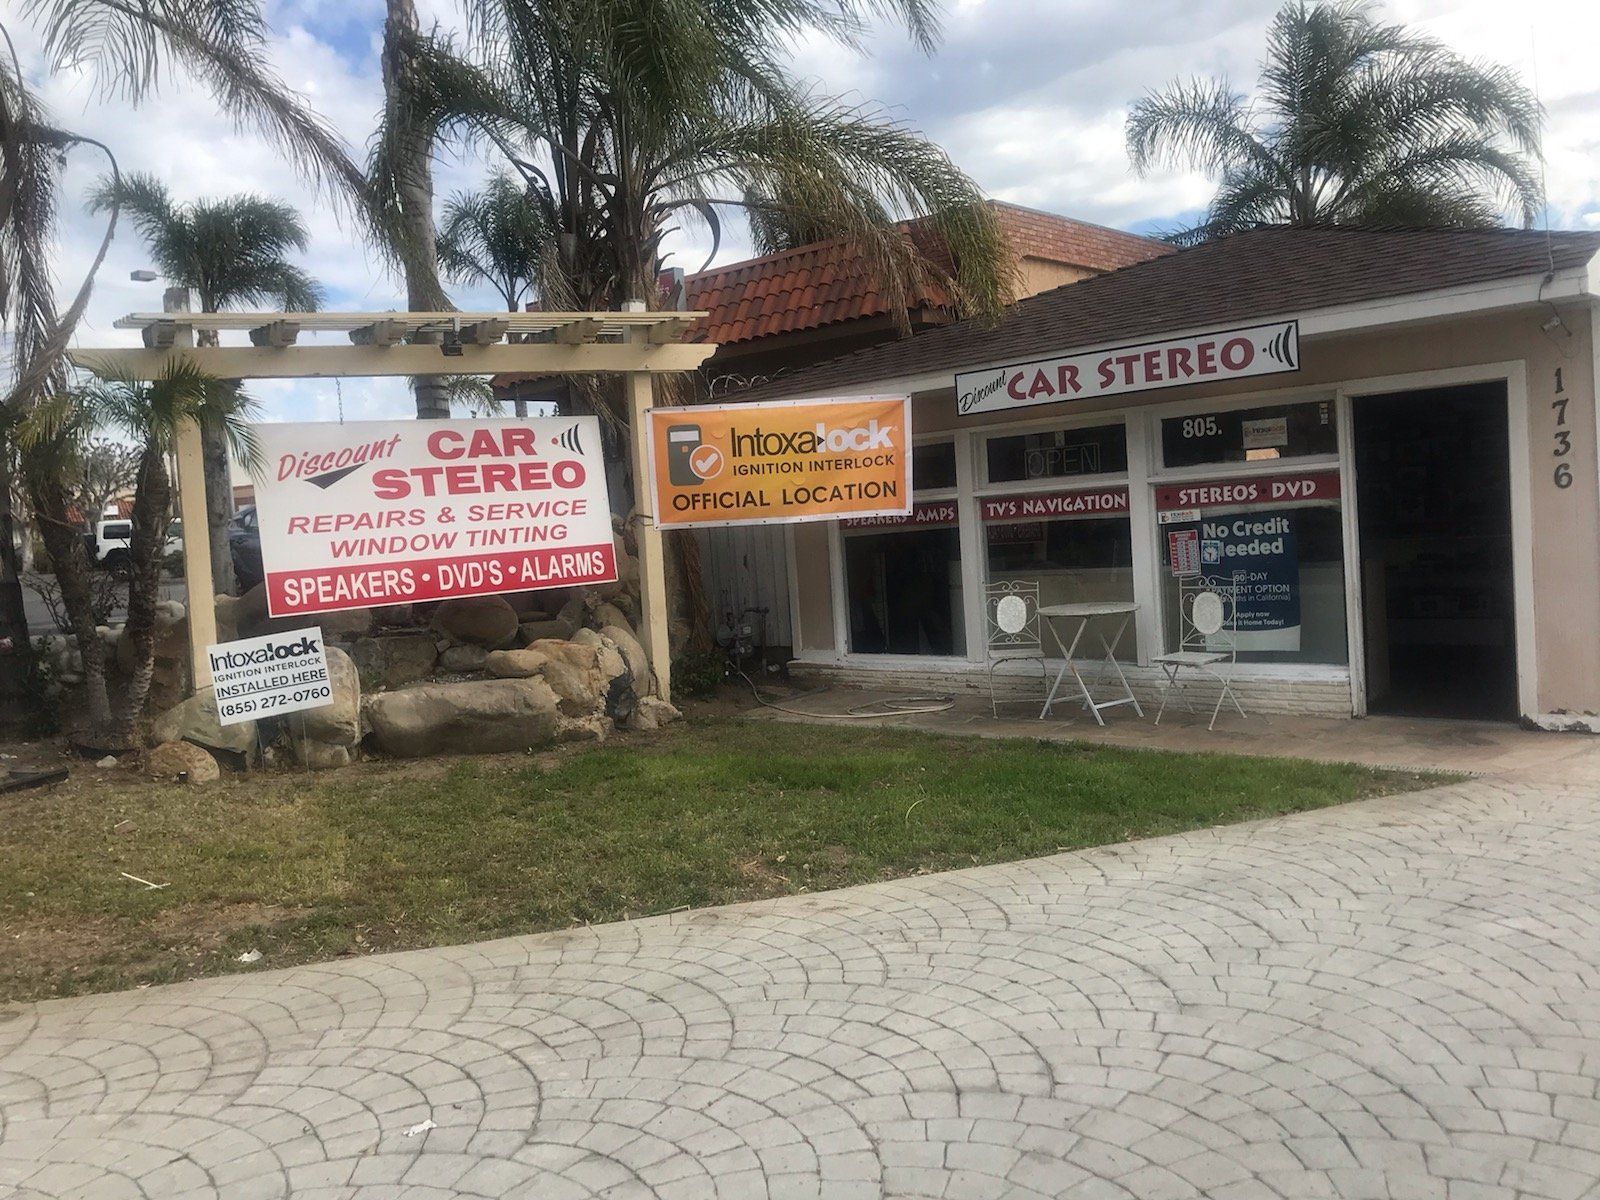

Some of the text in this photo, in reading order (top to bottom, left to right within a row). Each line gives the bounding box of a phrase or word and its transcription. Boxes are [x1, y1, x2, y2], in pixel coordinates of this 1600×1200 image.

[959, 337, 1255, 412] Discount CAR STEREO
[730, 419, 894, 458] Intoxalock
[1552, 366, 1573, 489] 1736
[277, 428, 538, 482] Discount CAR
[733, 454, 895, 476] IGNITION INTERLOCK
[1028, 446, 1097, 477] OPEN
[372, 460, 587, 500] STEREO
[1178, 480, 1316, 505] STEREOS DVD
[672, 480, 897, 512] OFFICIAL LOCATION
[987, 493, 1126, 517] TV'S NAVIGATION
[288, 499, 588, 535] REPAIRS & SERVICE
[916, 506, 955, 522] AMPS
[1202, 517, 1289, 539] No Credit
[330, 524, 568, 558] WINDOW TINTING
[284, 550, 605, 606] SPEAKERS DVD'S ALARMS
[1254, 584, 1290, 593] OPTION
[210, 637, 319, 672] Intoxalock
[214, 657, 322, 682] IGNITION INTERLOCK
[217, 668, 327, 698] INSTALLED HERE
[221, 686, 330, 717] (855) 272-0760
